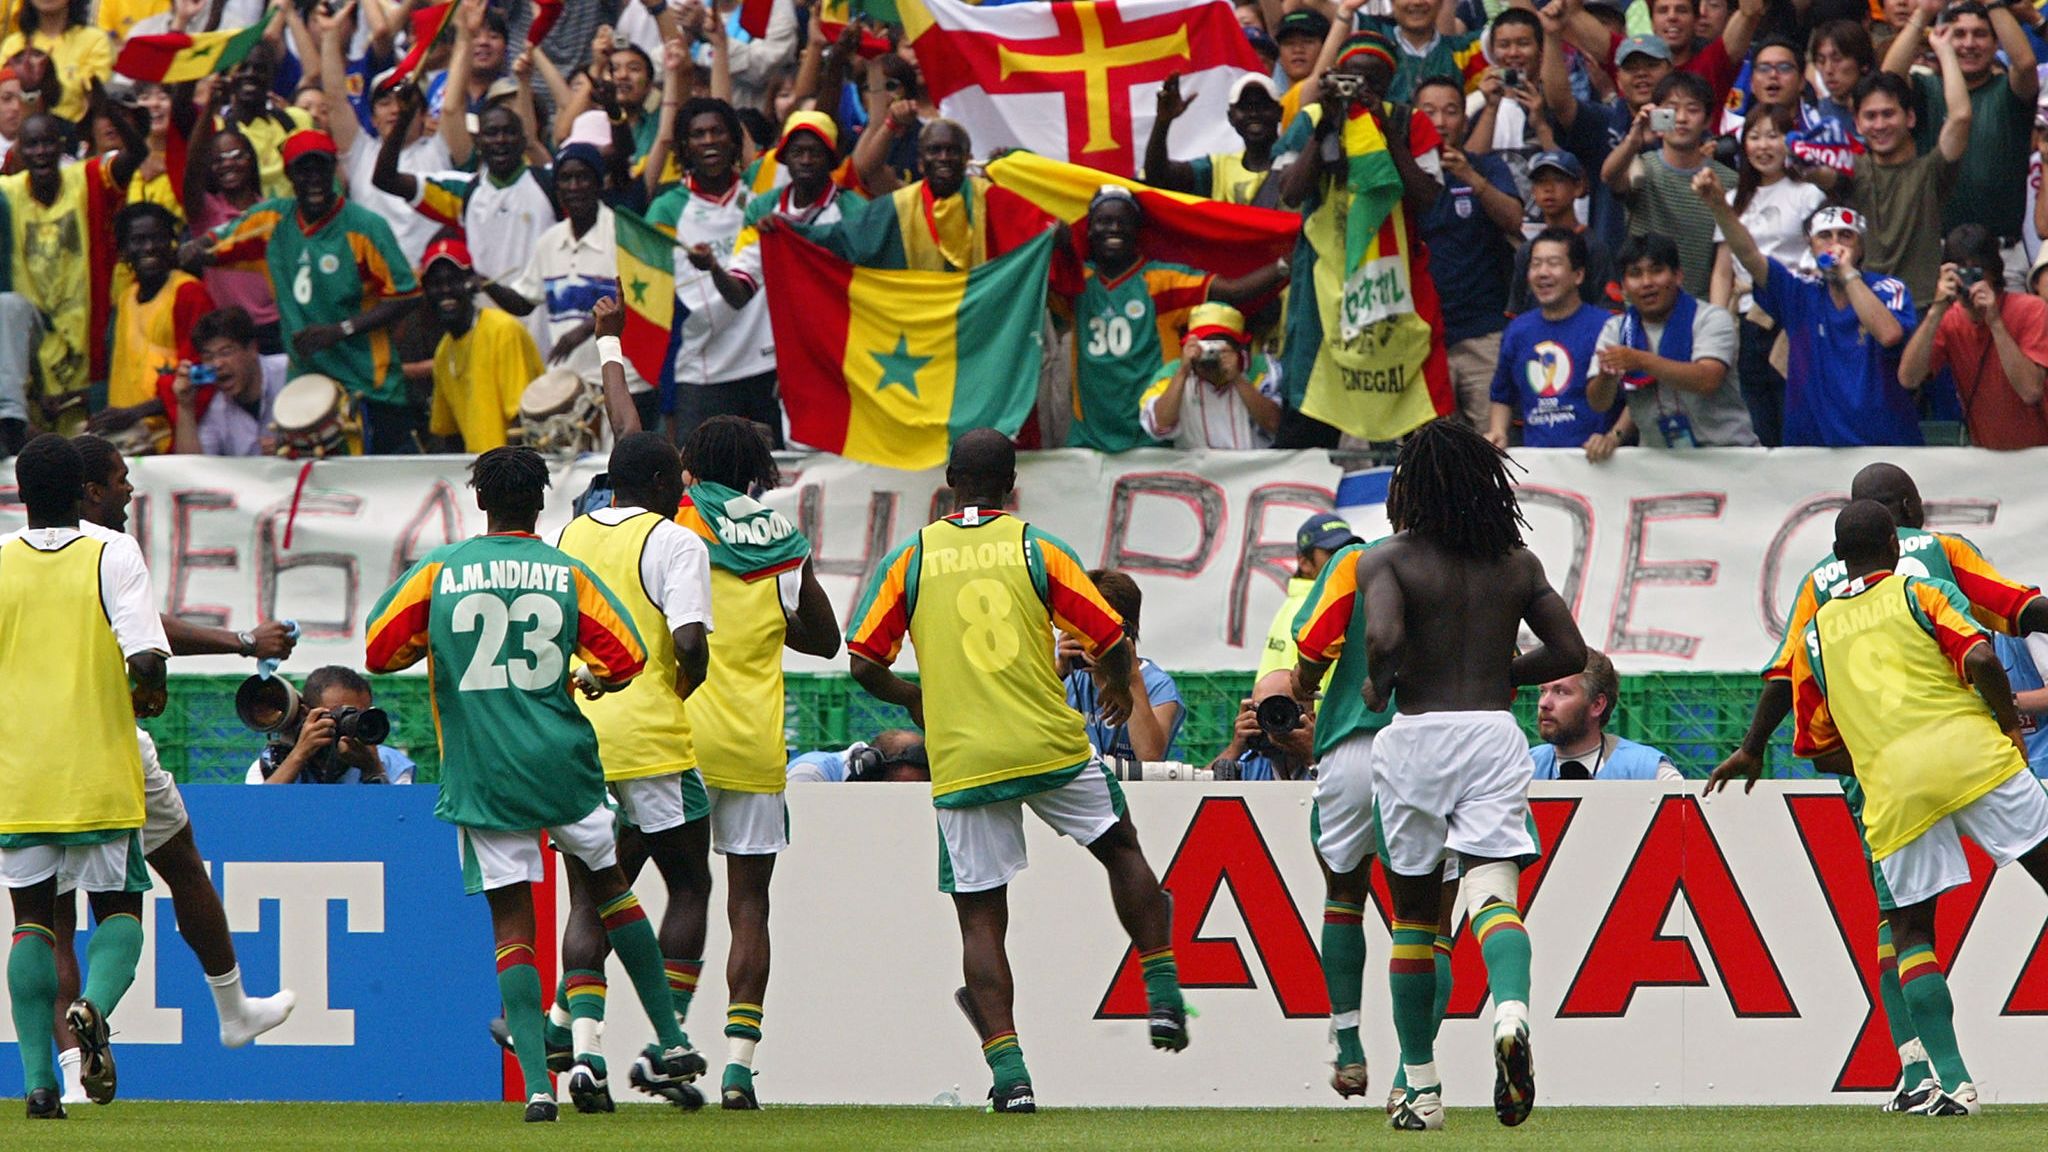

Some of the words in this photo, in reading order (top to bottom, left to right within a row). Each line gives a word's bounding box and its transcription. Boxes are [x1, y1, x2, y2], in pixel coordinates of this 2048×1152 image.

[293, 265, 313, 304] 6
[1088, 316, 1132, 357] 30
[439, 559, 570, 595] A.M.NDIAYE
[451, 592, 564, 692] 23
[956, 577, 1020, 673] 8
[1847, 631, 1908, 720] 9
[0, 861, 385, 1046] TT
[1093, 793, 2048, 1092] AVAY
